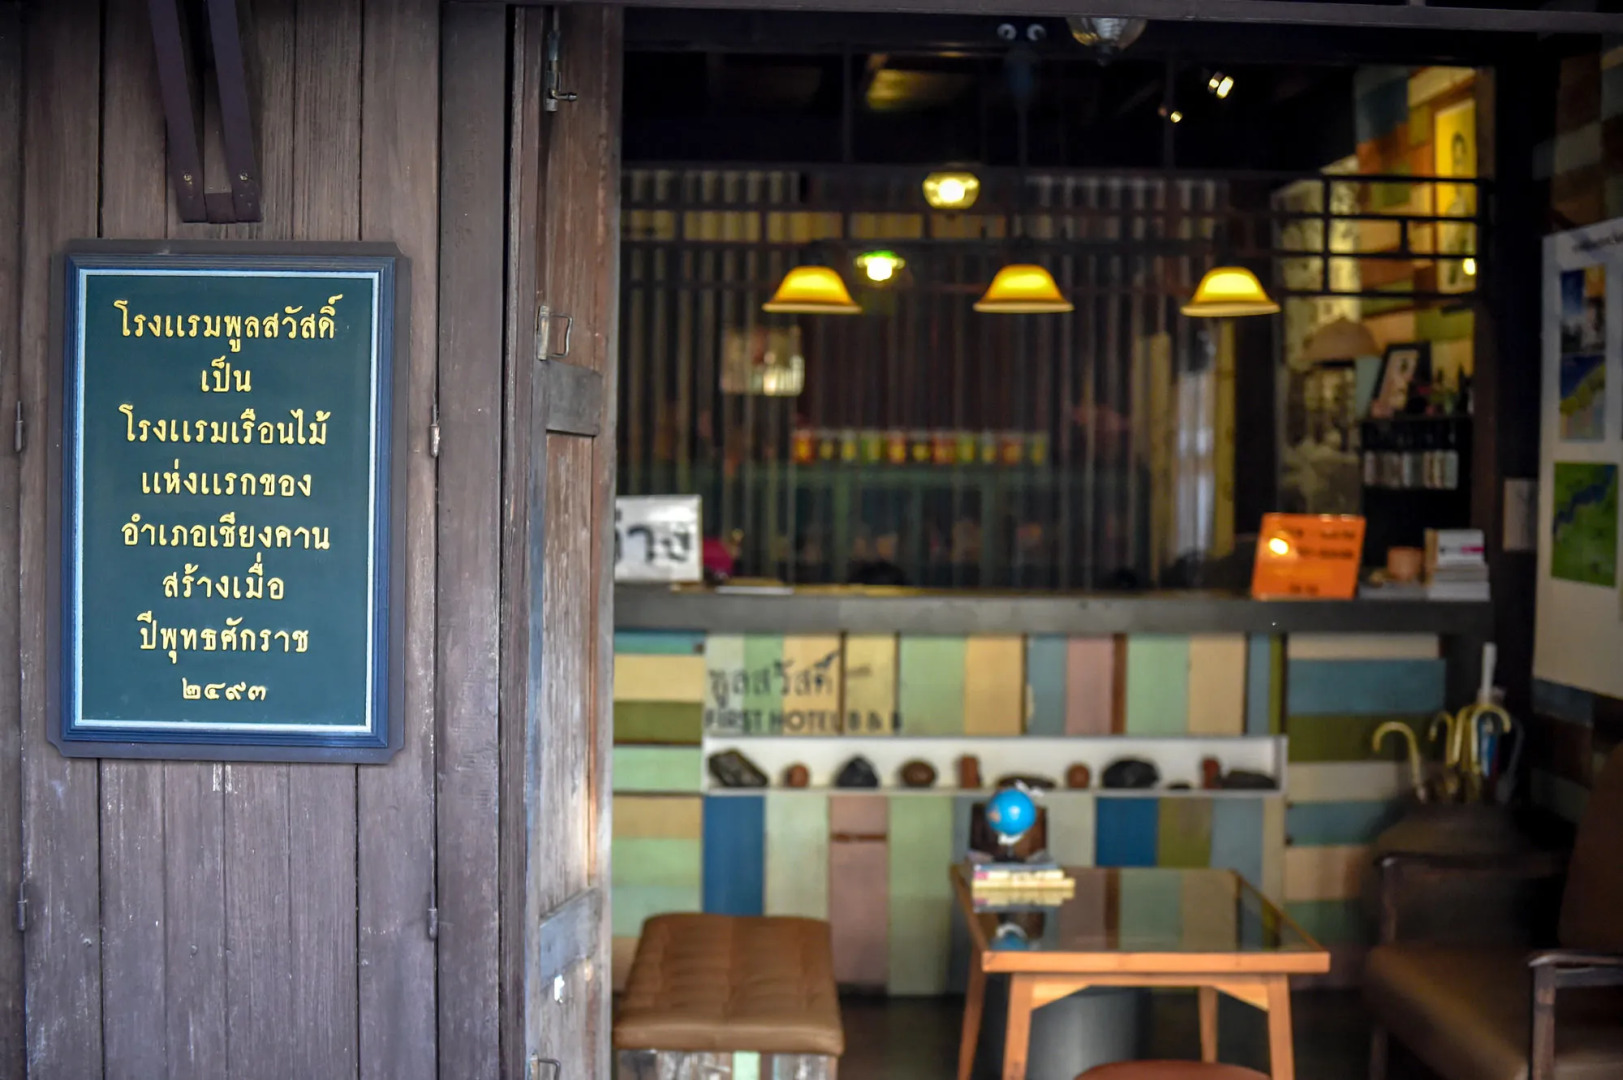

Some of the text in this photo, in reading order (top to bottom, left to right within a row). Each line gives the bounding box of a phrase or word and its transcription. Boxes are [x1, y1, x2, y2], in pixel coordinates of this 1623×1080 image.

[113, 293, 343, 353] โรงแรมพูลสวัสดิ์
[200, 355, 252, 393] เป็น
[118, 404, 331, 445] โรงแรมเรือนไม้
[141, 458, 313, 497] แห่งแรกของ
[122, 511, 331, 550] อำเภอเชียงคาน
[162, 552, 285, 600] สร้างเมื่อ
[136, 610, 310, 664] ปีพุทธศักราช
[181, 677, 267, 702] ๒๔๙๓
[705, 709, 762, 732] FIRST
[768, 709, 842, 732] HOTEL
